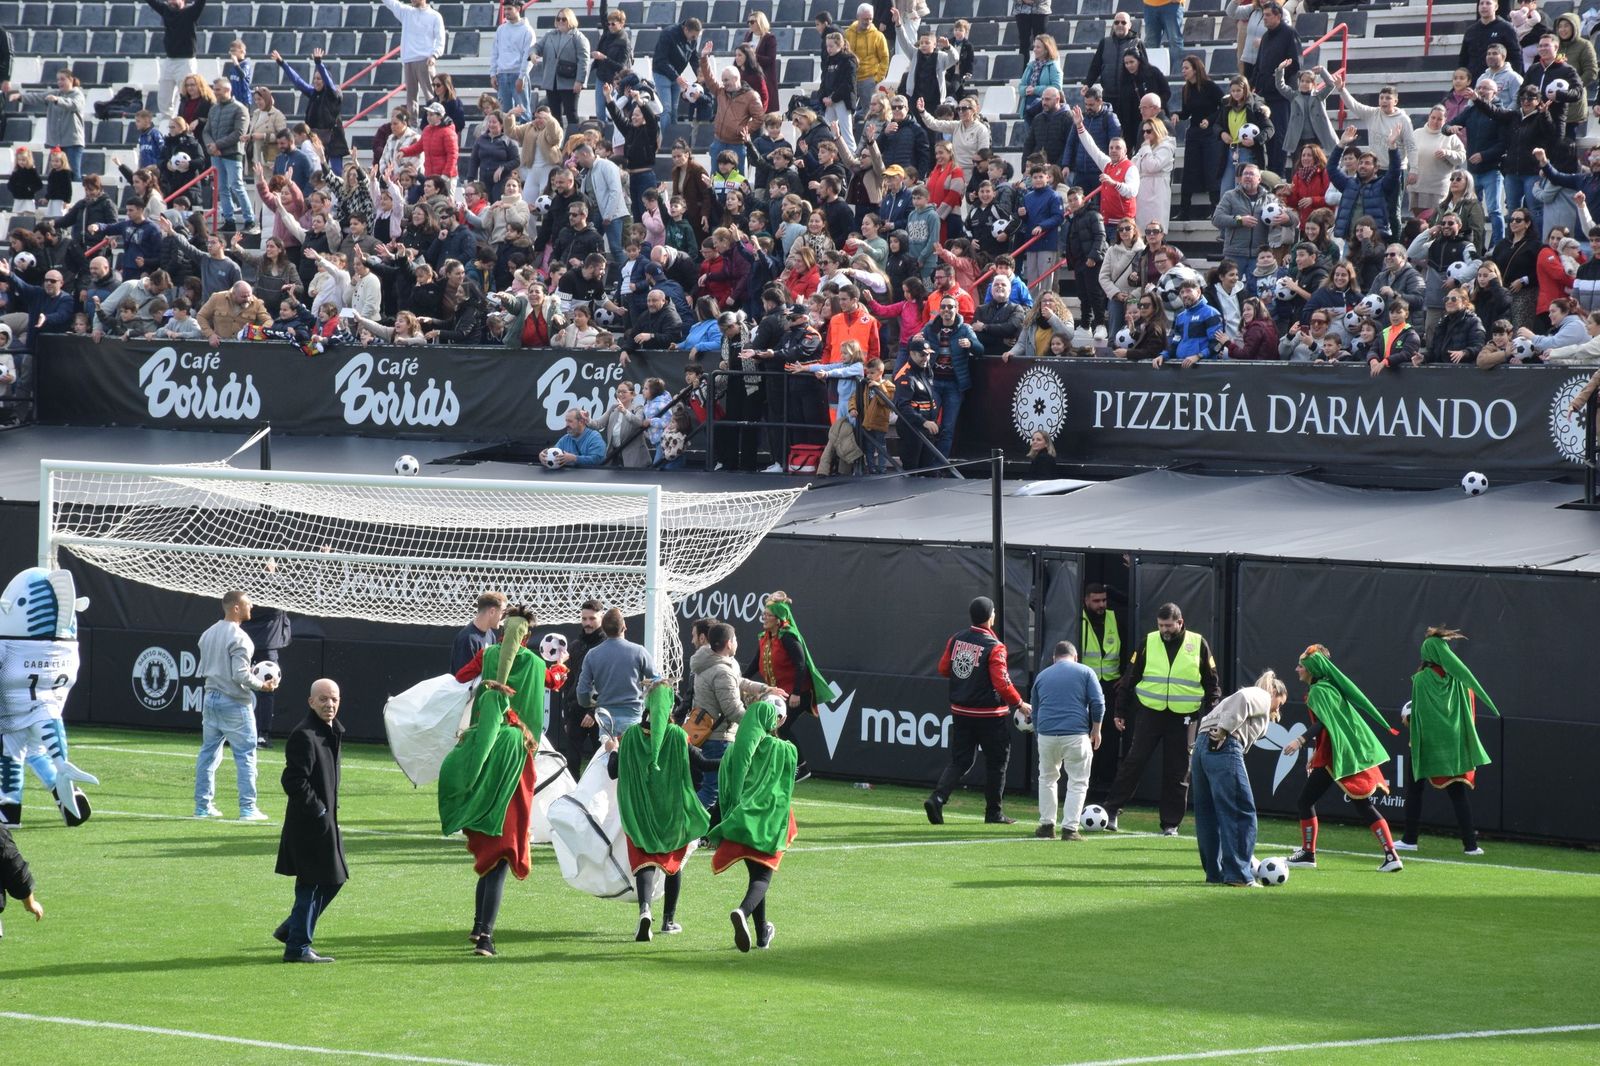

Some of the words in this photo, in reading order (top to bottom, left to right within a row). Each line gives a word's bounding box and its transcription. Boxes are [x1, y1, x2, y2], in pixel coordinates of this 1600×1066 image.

[180, 352, 221, 373] Café
[377, 357, 419, 379] Café
[581, 362, 624, 384] Café
[1093, 383, 1256, 432] PIZZERÍA
[1267, 392, 1518, 440] D'ARMANDO
[861, 707, 954, 749] macr
